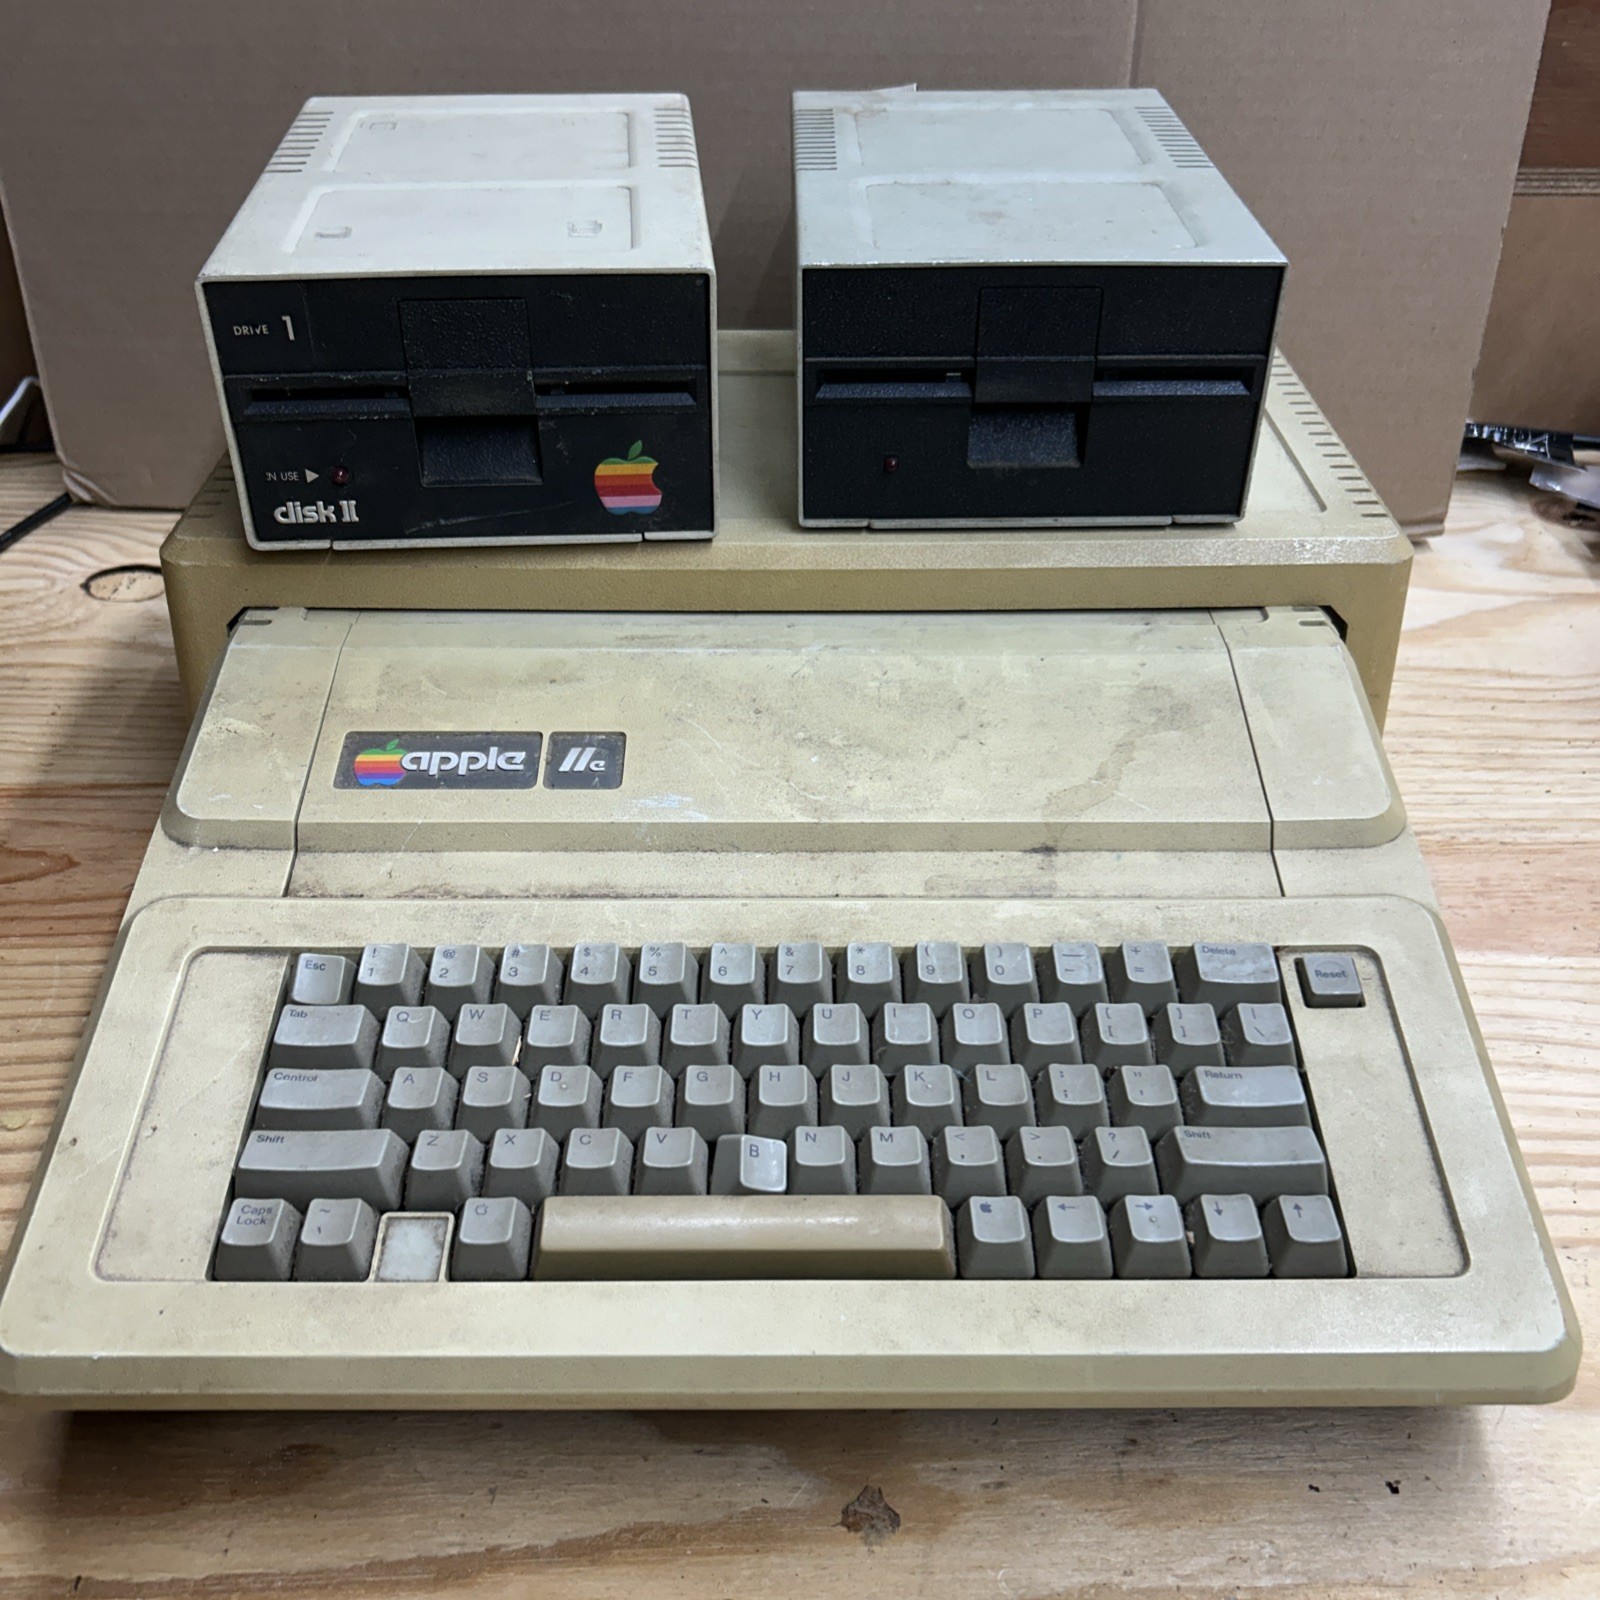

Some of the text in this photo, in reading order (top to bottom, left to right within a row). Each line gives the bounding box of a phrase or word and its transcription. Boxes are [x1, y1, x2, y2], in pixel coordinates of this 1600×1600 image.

[233, 316, 295, 340] DRIVE 1
[280, 471, 299, 481] USE
[273, 500, 335, 524] disk
[401, 747, 526, 776] apple
[442, 949, 456, 959] @
[583, 947, 591, 957] $
[650, 947, 661, 957] %
[785, 947, 794, 956] &
[1201, 945, 1237, 956] Delete
[304, 960, 326, 971] Esc
[785, 965, 795, 975] 7
[856, 965, 866, 975] 8
[926, 964, 935, 975] 9
[439, 968, 449, 979] 2
[508, 967, 518, 978] 3
[580, 966, 589, 976] 4
[648, 966, 657, 976] 5
[718, 966, 727, 976] 6
[1314, 970, 1346, 979] Reset
[289, 1009, 307, 1019] Tab
[396, 1012, 410, 1022] Q
[469, 1009, 485, 1020] W
[540, 1010, 551, 1021] E
[611, 1009, 622, 1020] R
[682, 1009, 692, 1020] T
[752, 1009, 762, 1020] Y
[821, 1009, 833, 1019] U
[1032, 1008, 1043, 1019] P
[274, 1072, 318, 1082] Control
[403, 1073, 415, 1084] A
[477, 1072, 488, 1082] S
[550, 1072, 562, 1082] D
[623, 1072, 634, 1082] F
[696, 1071, 708, 1082] G
[769, 1071, 780, 1081] H
[842, 1071, 850, 1081] J
[914, 1071, 925, 1081] K
[986, 1071, 996, 1081] L
[1205, 1071, 1242, 1080] Return
[256, 1134, 285, 1144] Shift
[505, 1134, 516, 1145] X
[579, 1134, 591, 1145] C
[656, 1133, 667, 1144] V
[805, 1132, 817, 1142] N
[880, 1133, 894, 1142] M
[1108, 1132, 1116, 1141] ?
[1183, 1130, 1212, 1139] Shift
[426, 1136, 439, 1146] Z
[749, 1144, 760, 1158] B
[241, 1204, 273, 1216] Caps
[237, 1216, 267, 1226] Lock
